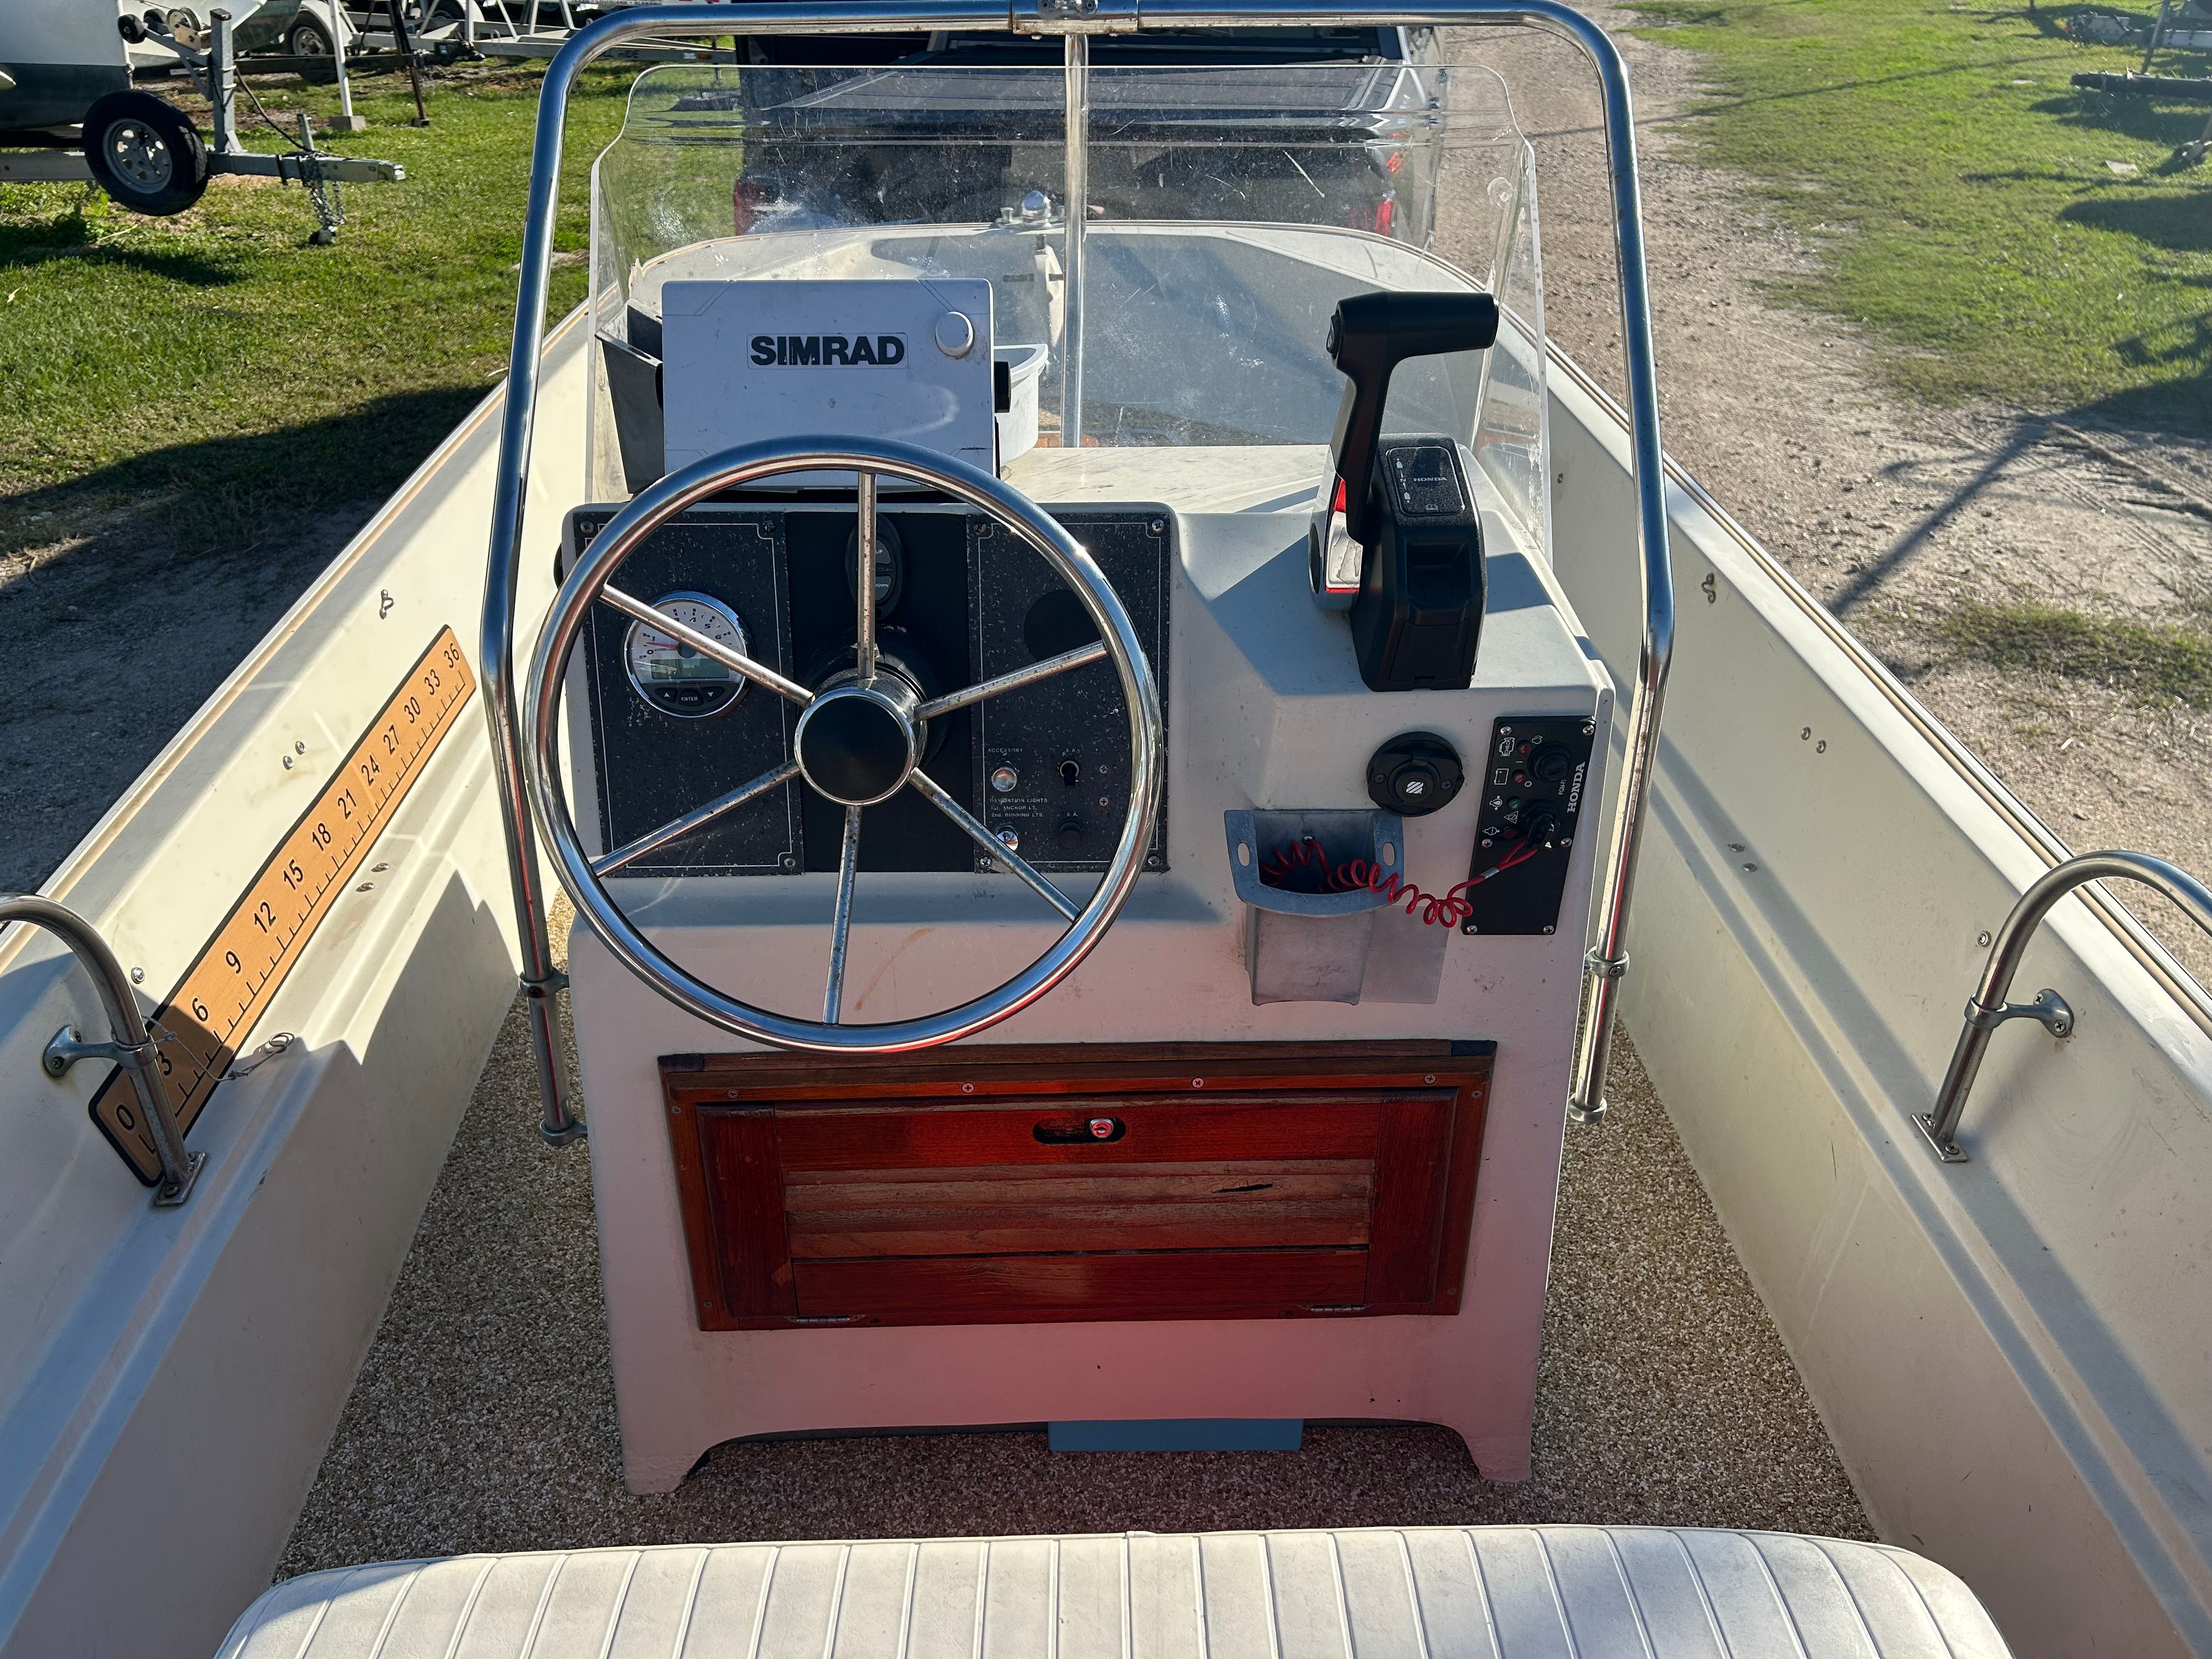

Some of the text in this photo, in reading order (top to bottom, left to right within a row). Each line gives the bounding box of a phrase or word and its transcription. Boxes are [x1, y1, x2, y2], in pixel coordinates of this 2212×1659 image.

[751, 336, 905, 366] SIMRAD
[1558, 779, 1567, 795] PGM-FI
[1567, 761, 1585, 813] HONDA
[116, 642, 459, 1131] 0 3 6 9 12 15 18 21 24 27 30 33 36
